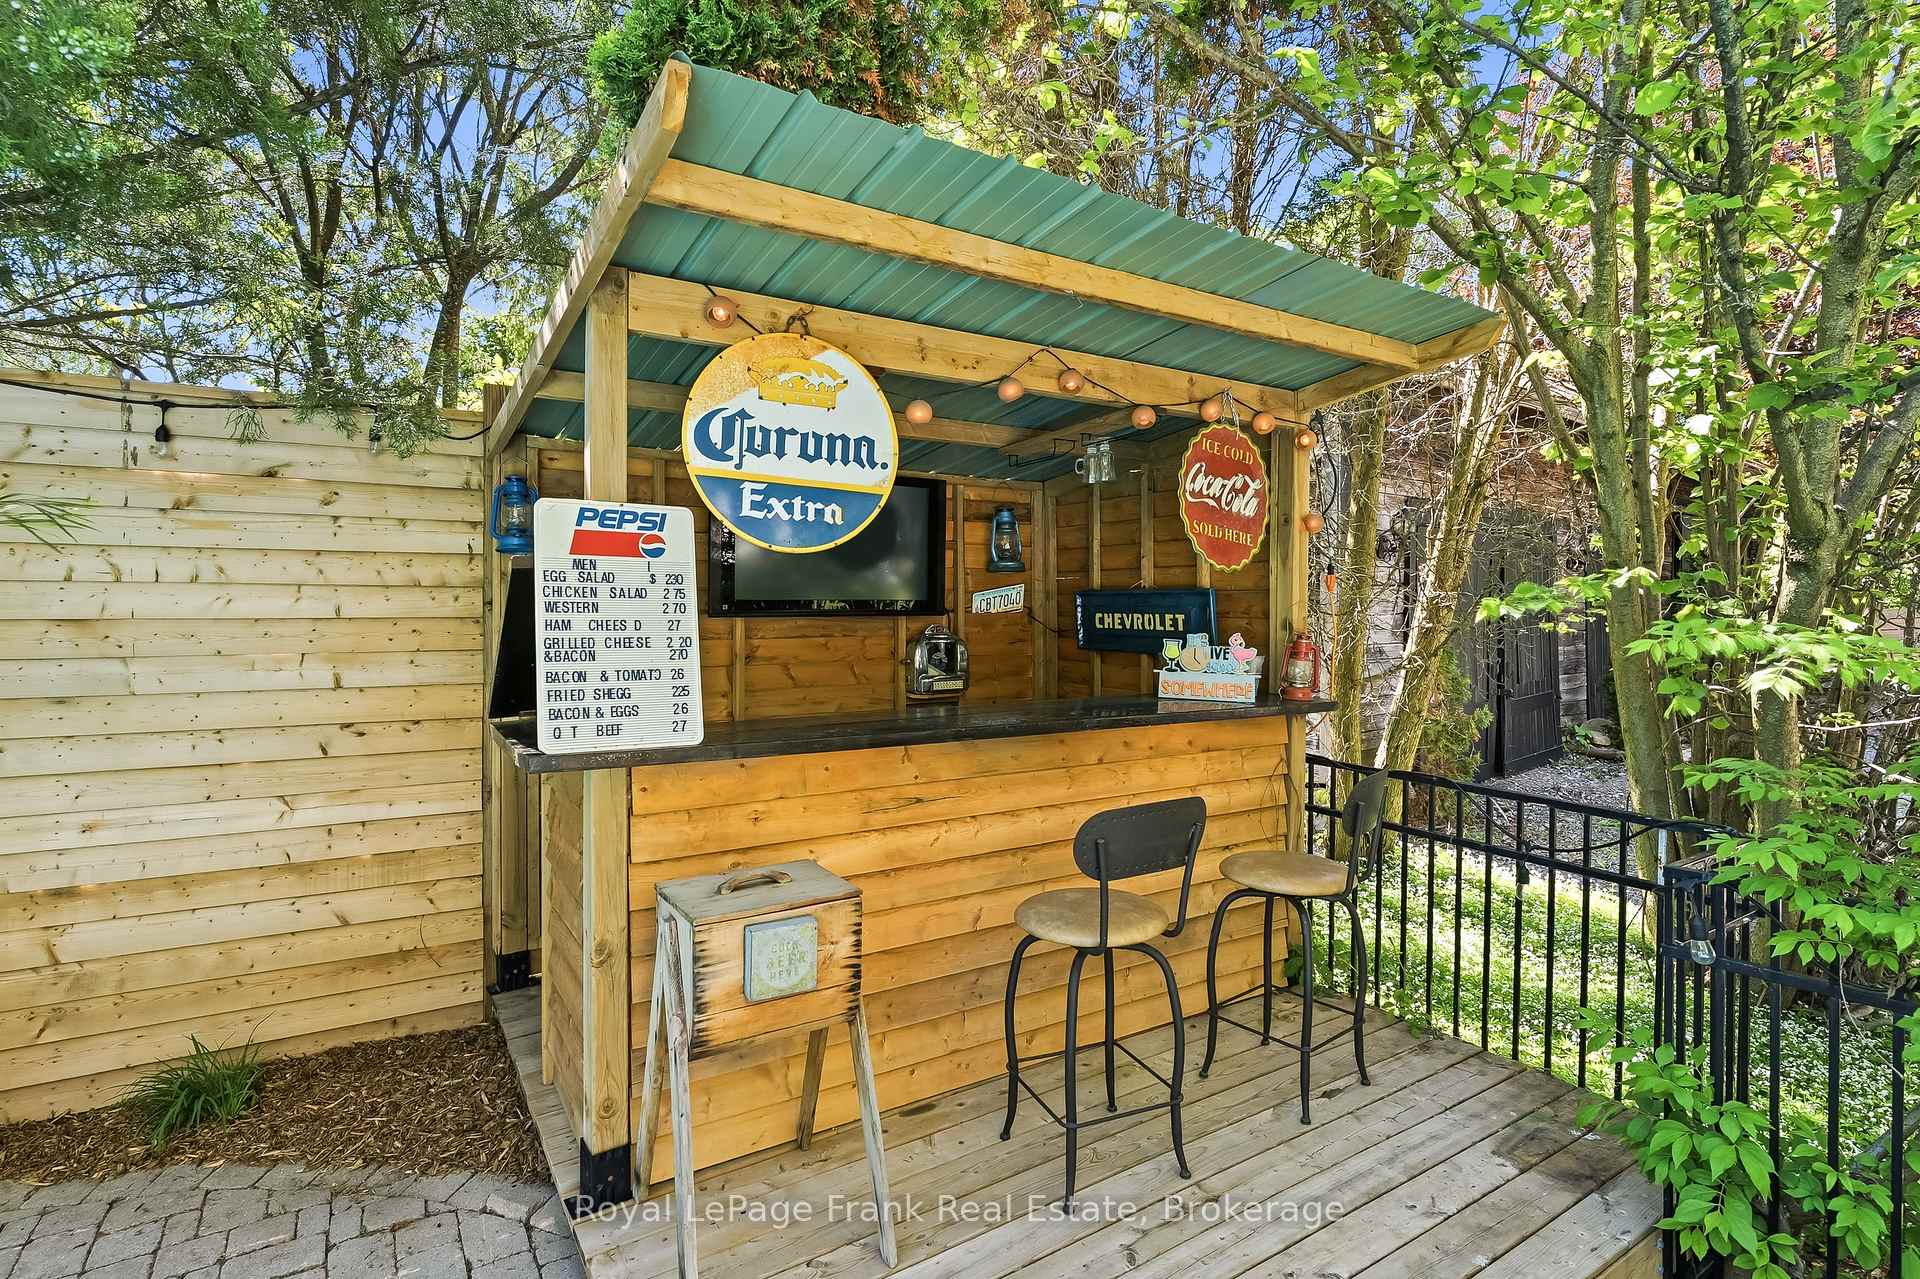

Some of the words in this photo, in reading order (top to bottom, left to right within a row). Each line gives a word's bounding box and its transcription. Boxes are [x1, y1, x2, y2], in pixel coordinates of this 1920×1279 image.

[1202, 437, 1221, 456] ICE
[1223, 444, 1254, 465] COLD
[739, 481, 845, 525] Extra
[575, 507, 668, 532] PEPSI
[1192, 519, 1223, 539] SOLD
[1224, 528, 1254, 547] HERE
[572, 559, 597, 571] MEN
[543, 570, 567, 583] EGG
[577, 571, 615, 584] SALAD
[665, 573, 684, 585] 230
[543, 585, 598, 599] CHICKEN
[609, 586, 648, 599] SALAD
[544, 601, 599, 614] WESTERN
[545, 619, 571, 631] HAM
[588, 619, 627, 632] CHEES
[667, 619, 681, 631] 27
[1095, 612, 1185, 632] CHEVROLET
[543, 637, 596, 650] GRILLED
[604, 636, 651, 649] CHEESE
[1210, 646, 1230, 660] IVE
[545, 670, 587, 683] BACON
[600, 670, 609, 682] &
[670, 668, 684, 680] 26
[547, 689, 585, 702] FRIED
[593, 687, 631, 700] SHEGG
[671, 685, 690, 697] 225
[548, 706, 590, 720] BACON
[595, 706, 605, 719] &
[611, 705, 640, 718] EGGS
[672, 703, 689, 715] 26
[596, 724, 624, 737] BEEF
[672, 720, 687, 733] 27
